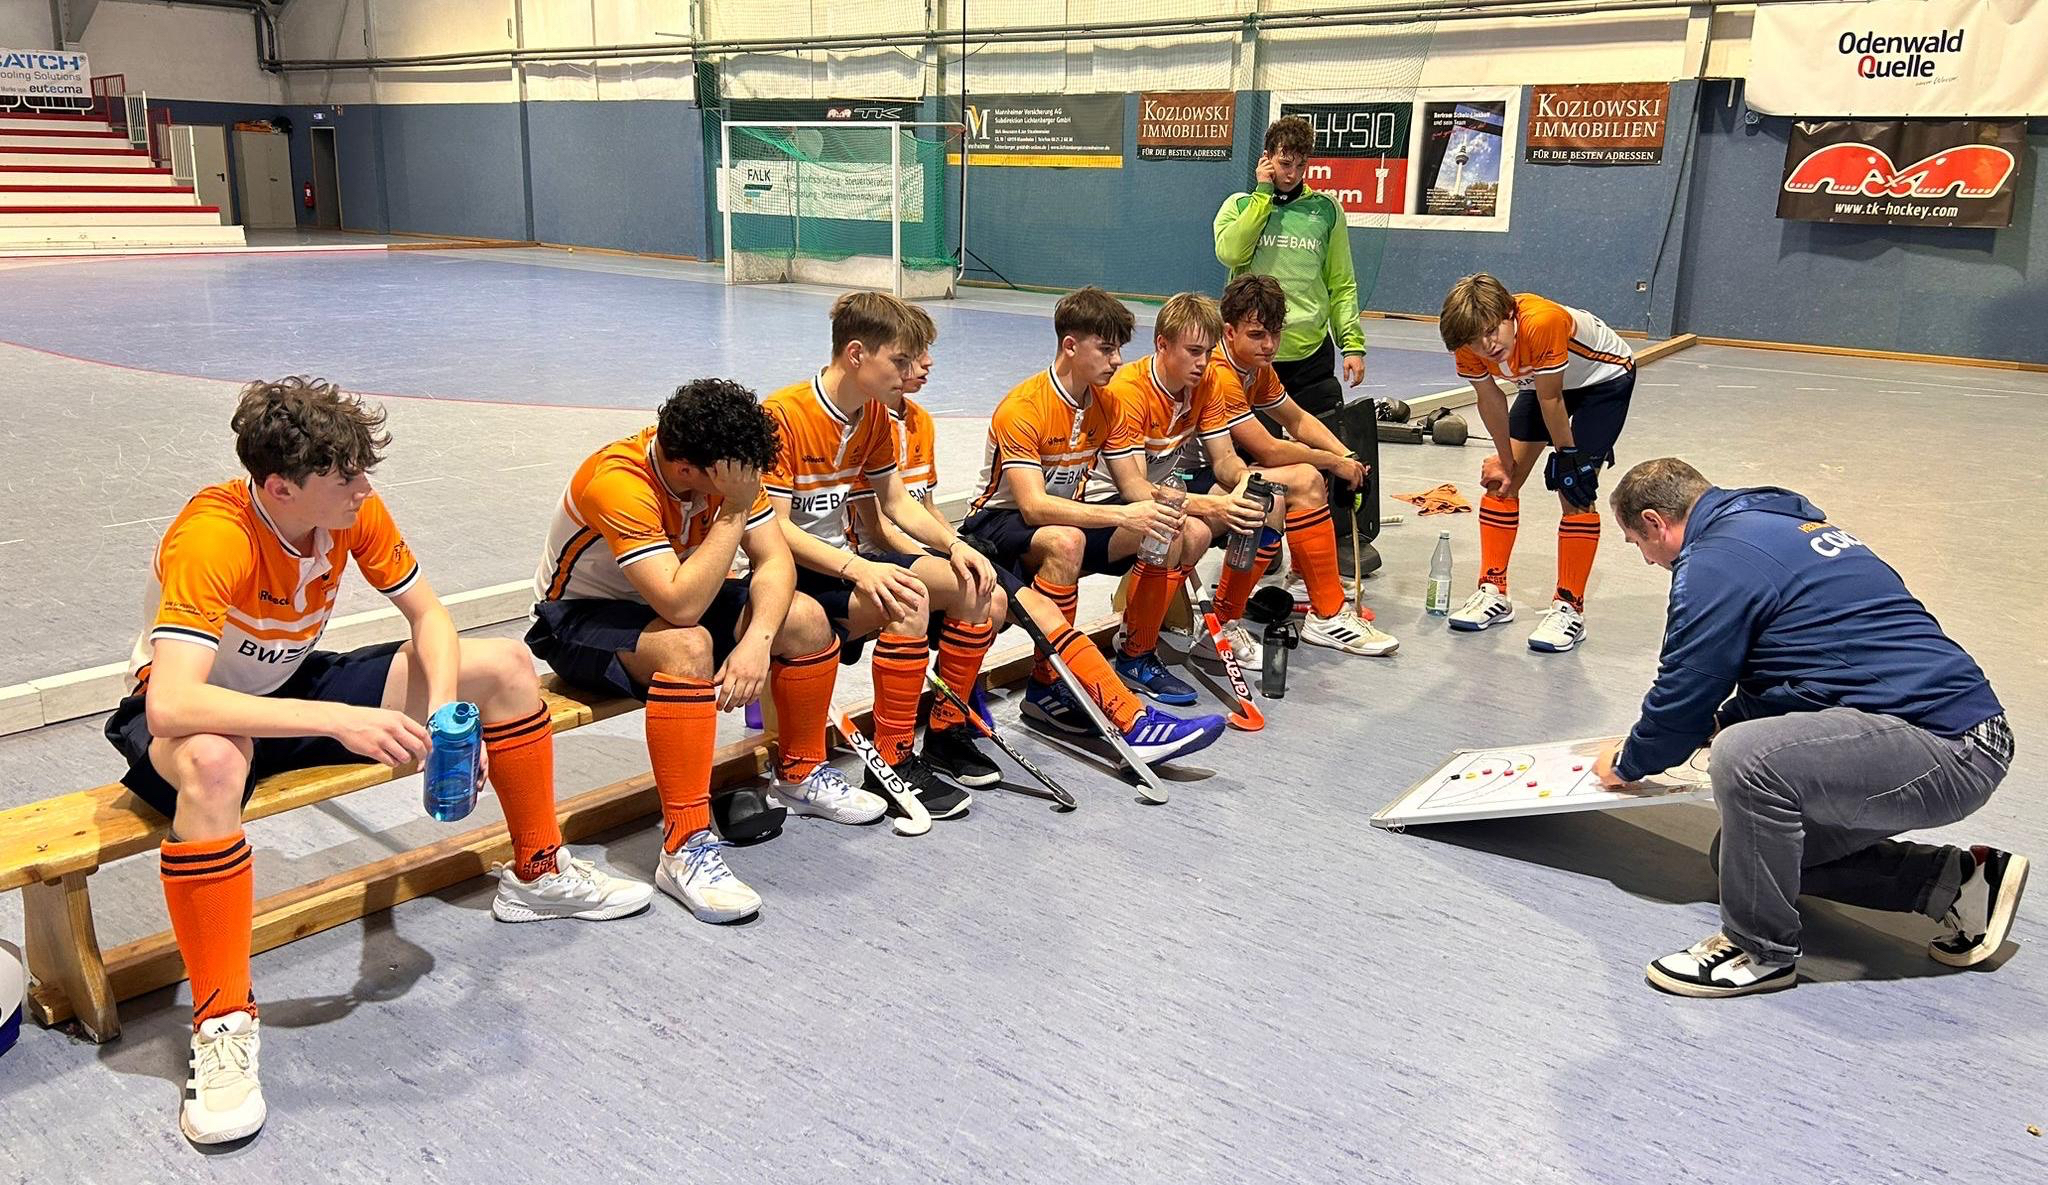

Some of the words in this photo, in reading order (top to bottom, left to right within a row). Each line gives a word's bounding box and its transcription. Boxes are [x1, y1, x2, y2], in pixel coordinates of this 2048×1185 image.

[1838, 29, 1965, 55] Odenwald
[0, 53, 80, 71] ATCH
[1857, 54, 1936, 79] Quelle
[34, 71, 82, 81] Solutions
[29, 84, 83, 94] eutecma
[1143, 100, 1230, 121] KOZLOWSKI
[1537, 92, 1662, 118] KOZLOWSKI
[1142, 124, 1229, 138] IMMOBILIEN
[1534, 121, 1658, 138] IMMOBILIEN
[1141, 148, 1154, 156] FÜR
[1155, 148, 1167, 156] DIE
[1533, 149, 1549, 159] FÜR
[1552, 151, 1568, 159] DIE
[1570, 151, 1604, 160] BESTEN
[1605, 152, 1655, 160] ADRESSEN
[747, 169, 771, 182] FALK
[1834, 202, 1959, 220] www.tk-hockey.com
